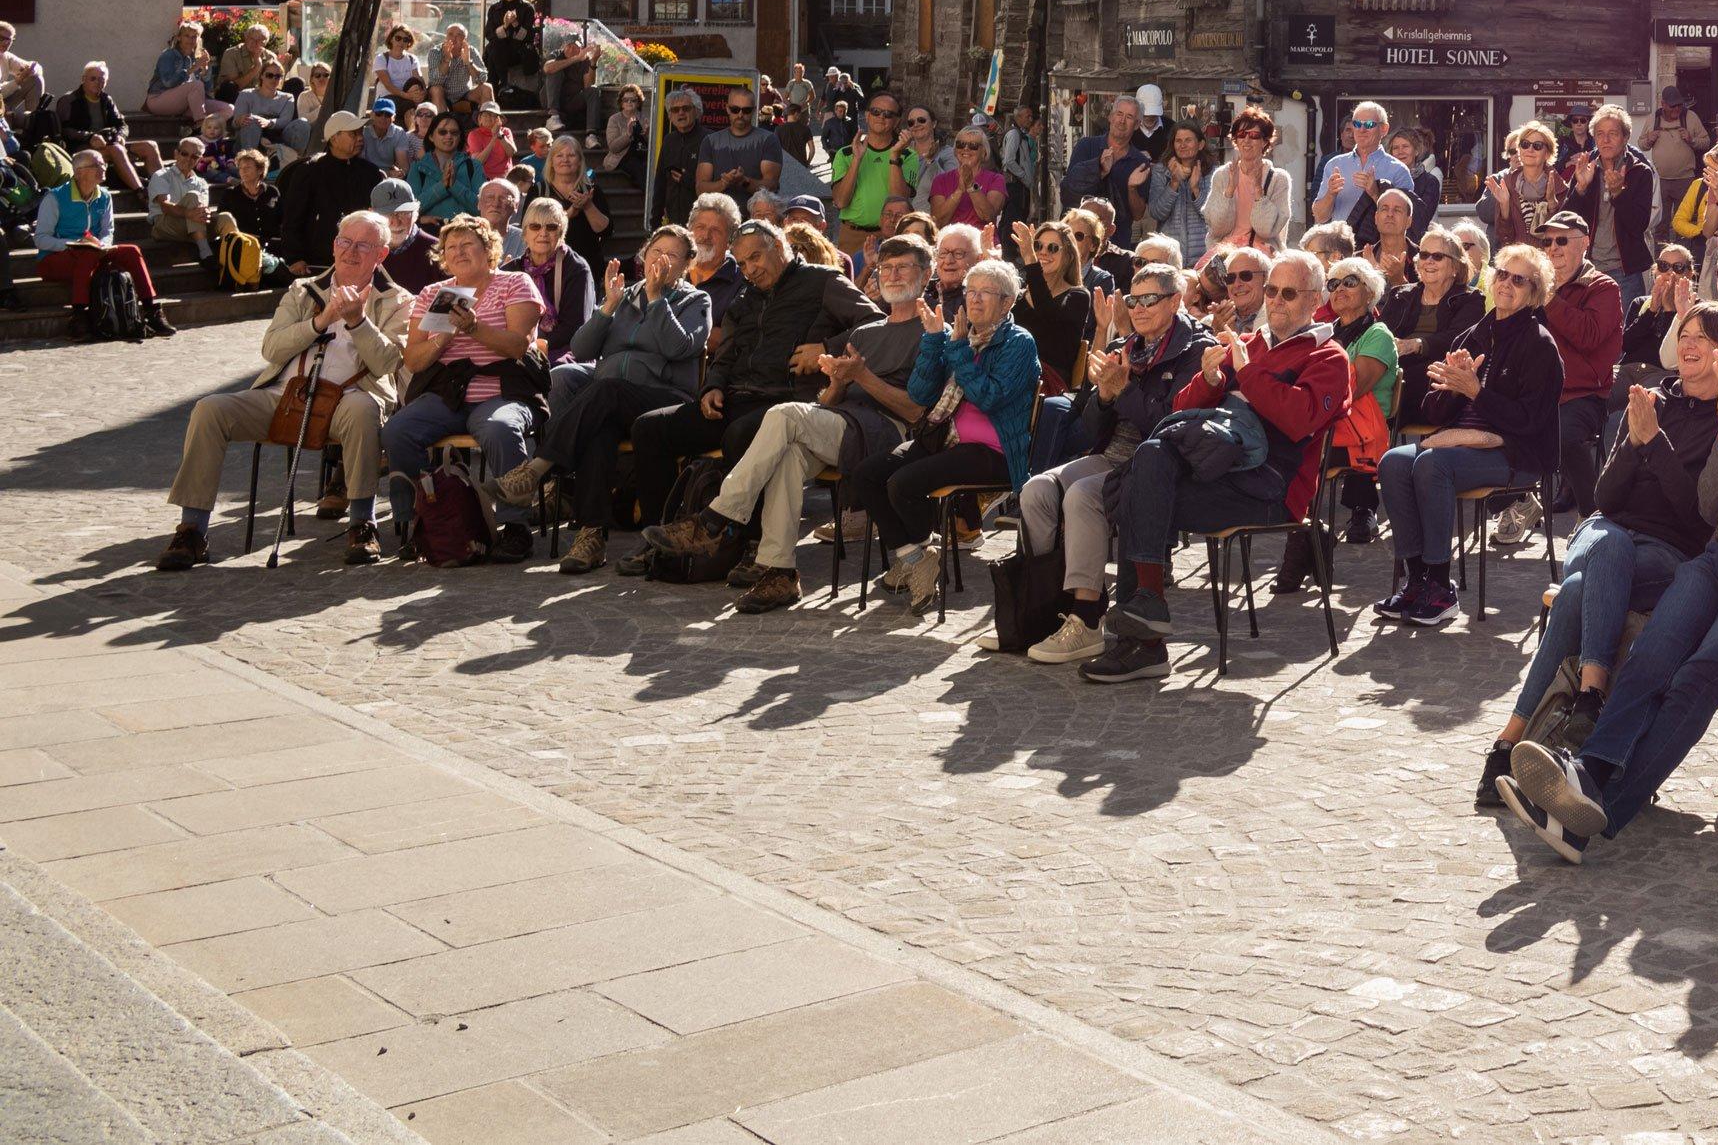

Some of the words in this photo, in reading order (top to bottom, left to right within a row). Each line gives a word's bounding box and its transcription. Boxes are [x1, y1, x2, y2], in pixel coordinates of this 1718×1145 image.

[1132, 29, 1173, 46] MARCOPOLO
[1397, 27, 1472, 44] Kristallgeheimnis
[1668, 24, 1702, 38] VICTOR
[1290, 45, 1333, 53] MARCOPOLO
[1386, 48, 1439, 65] HOTEL
[1446, 50, 1501, 66] SONNE
